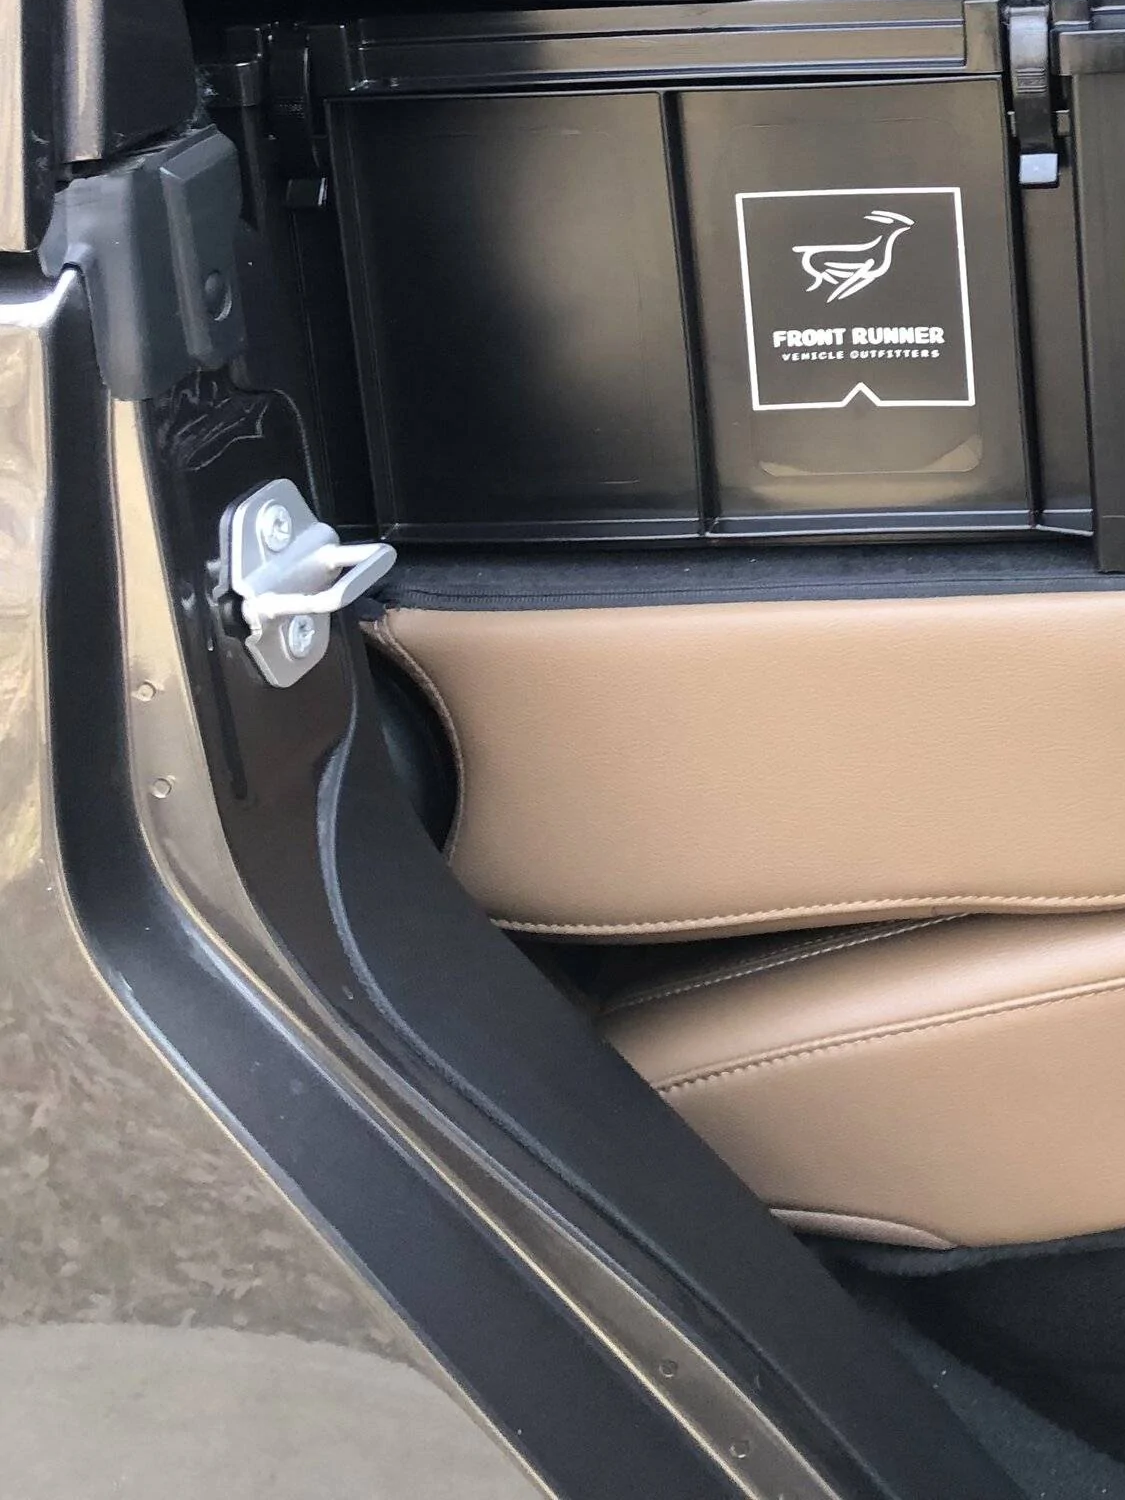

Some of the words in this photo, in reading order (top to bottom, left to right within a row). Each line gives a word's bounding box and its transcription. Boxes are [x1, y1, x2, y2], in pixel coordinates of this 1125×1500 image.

[772, 328, 846, 348] FRONT
[851, 326, 945, 345] RUNNER
[781, 351, 845, 362] VEHICLE
[849, 349, 940, 360] OUTFITTERS
